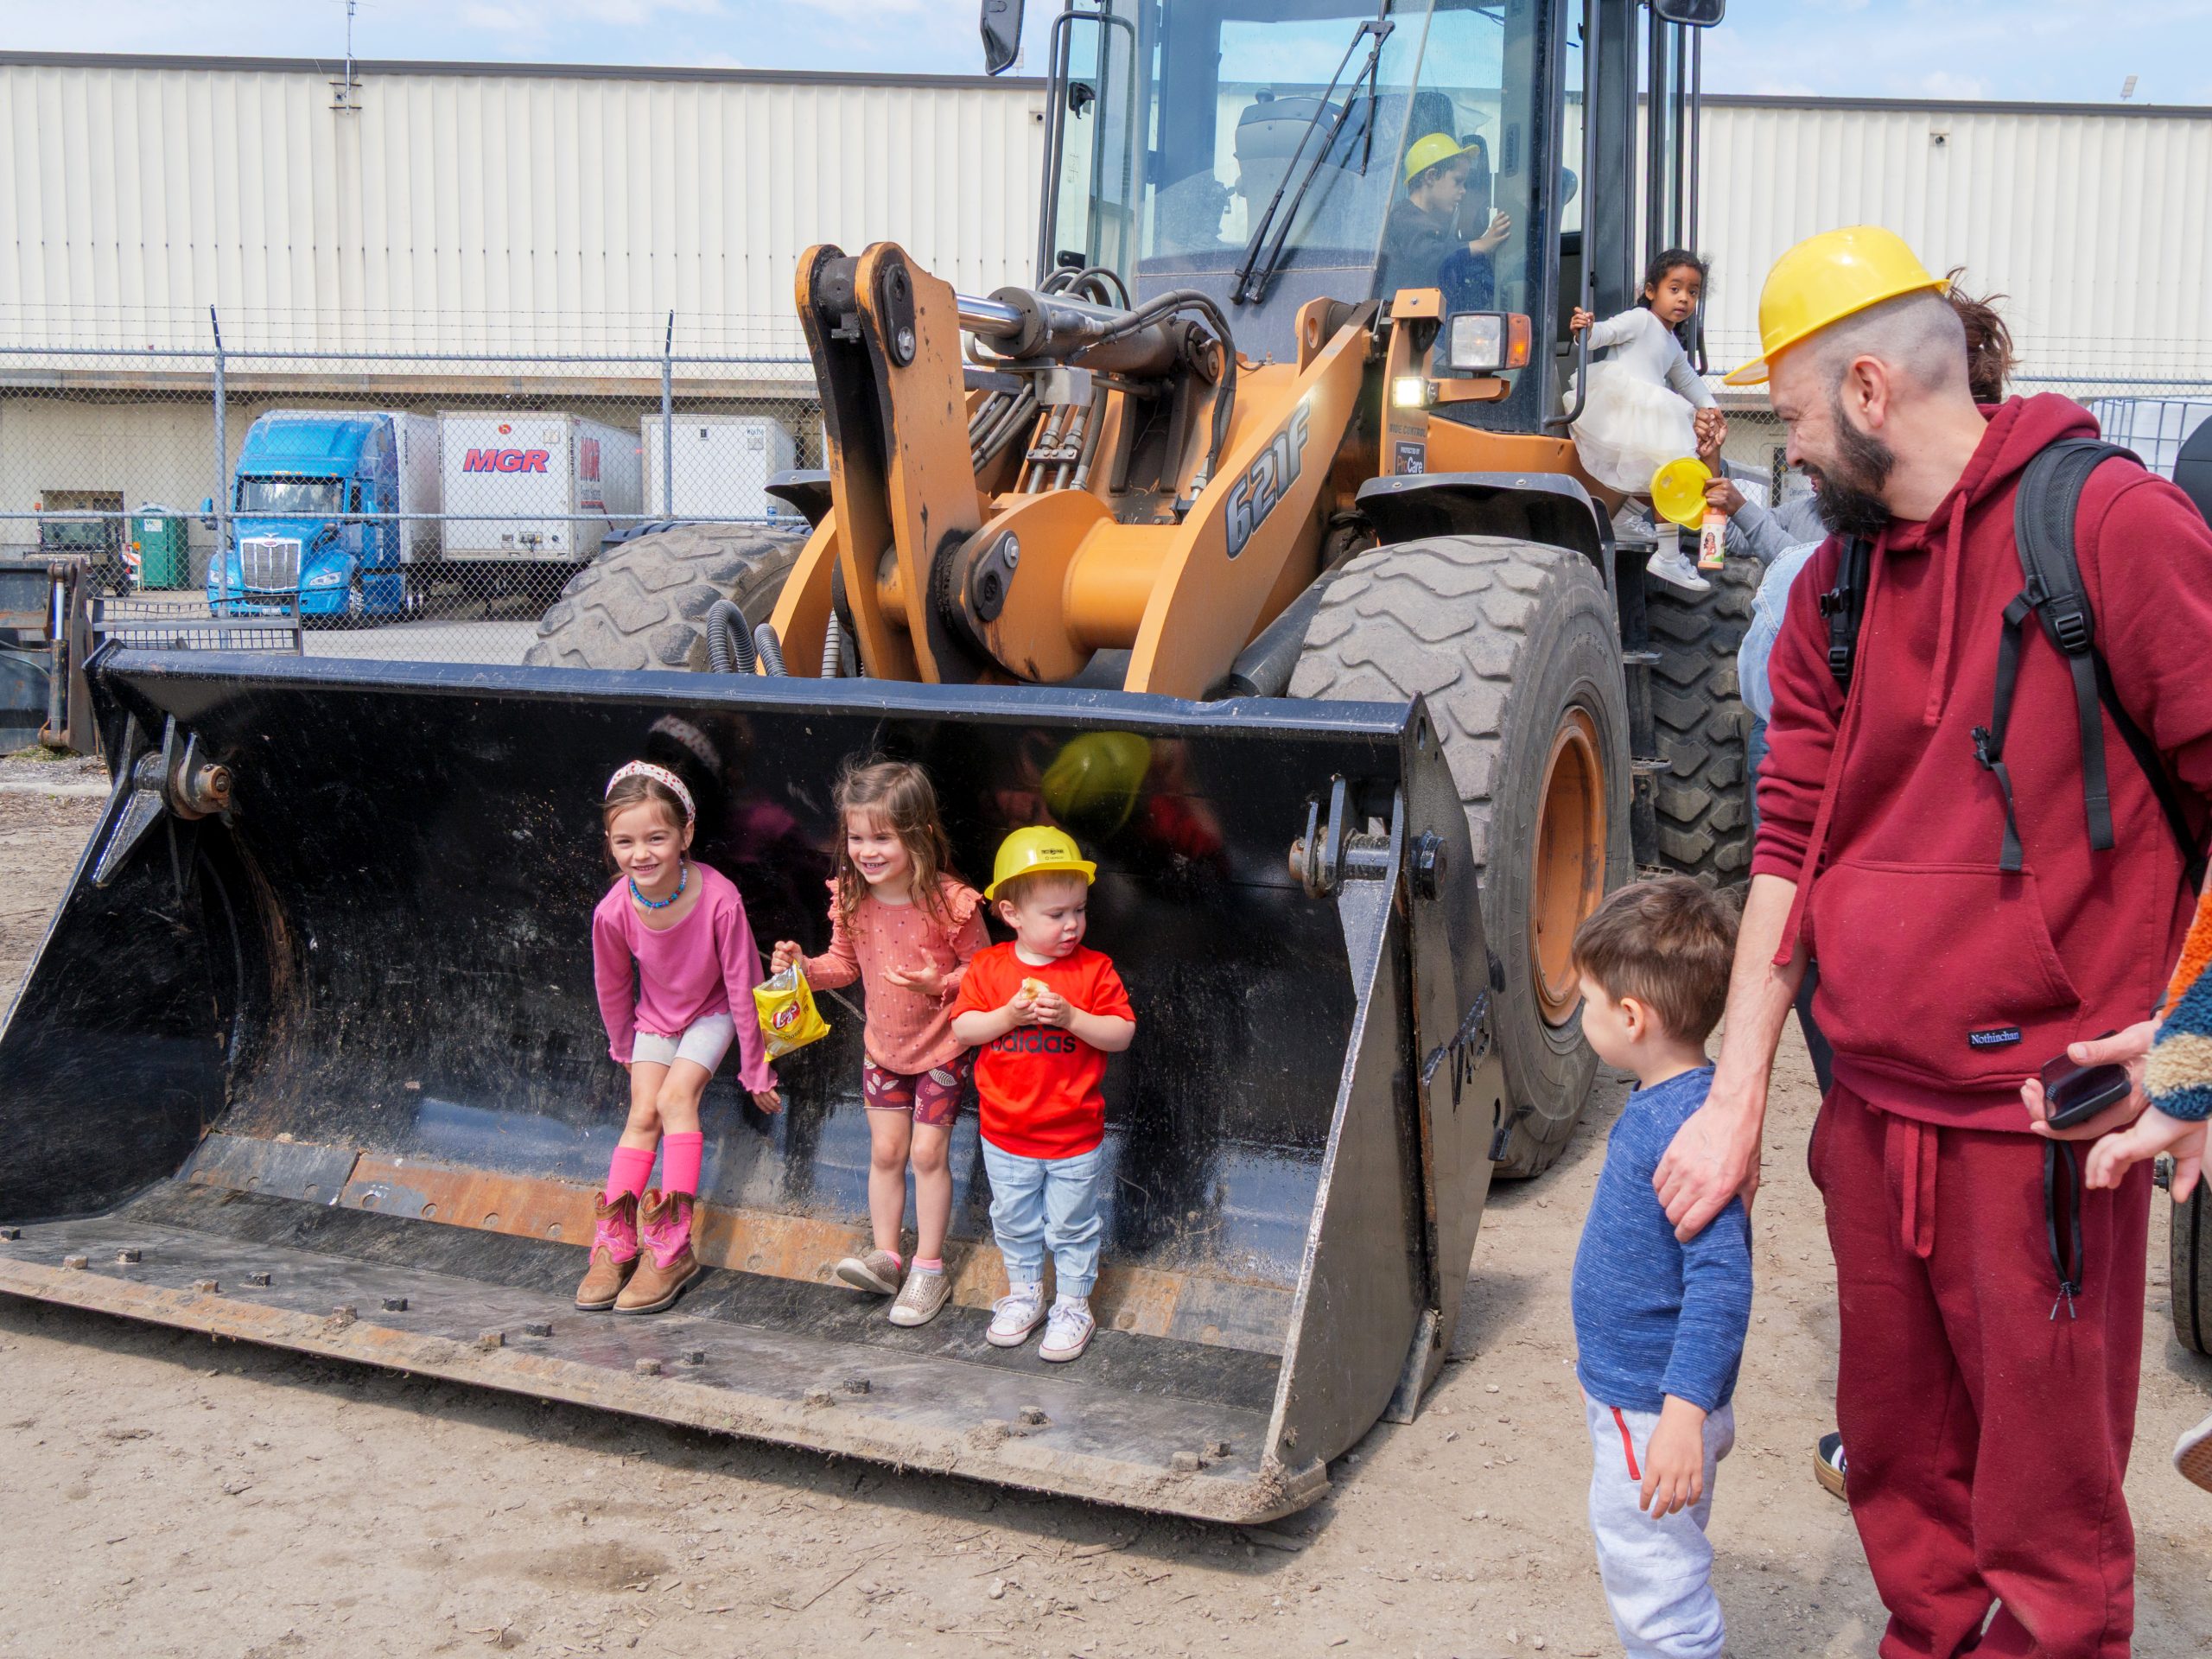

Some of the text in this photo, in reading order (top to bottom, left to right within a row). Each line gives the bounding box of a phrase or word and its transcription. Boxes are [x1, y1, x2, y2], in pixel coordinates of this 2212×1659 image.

[1403, 425, 1426, 437] CONTROL
[463, 448, 550, 473] MGR
[1396, 454, 1423, 474] ProCare
[1226, 399, 1311, 560] 621F
[775, 1004, 798, 1028] Lay's
